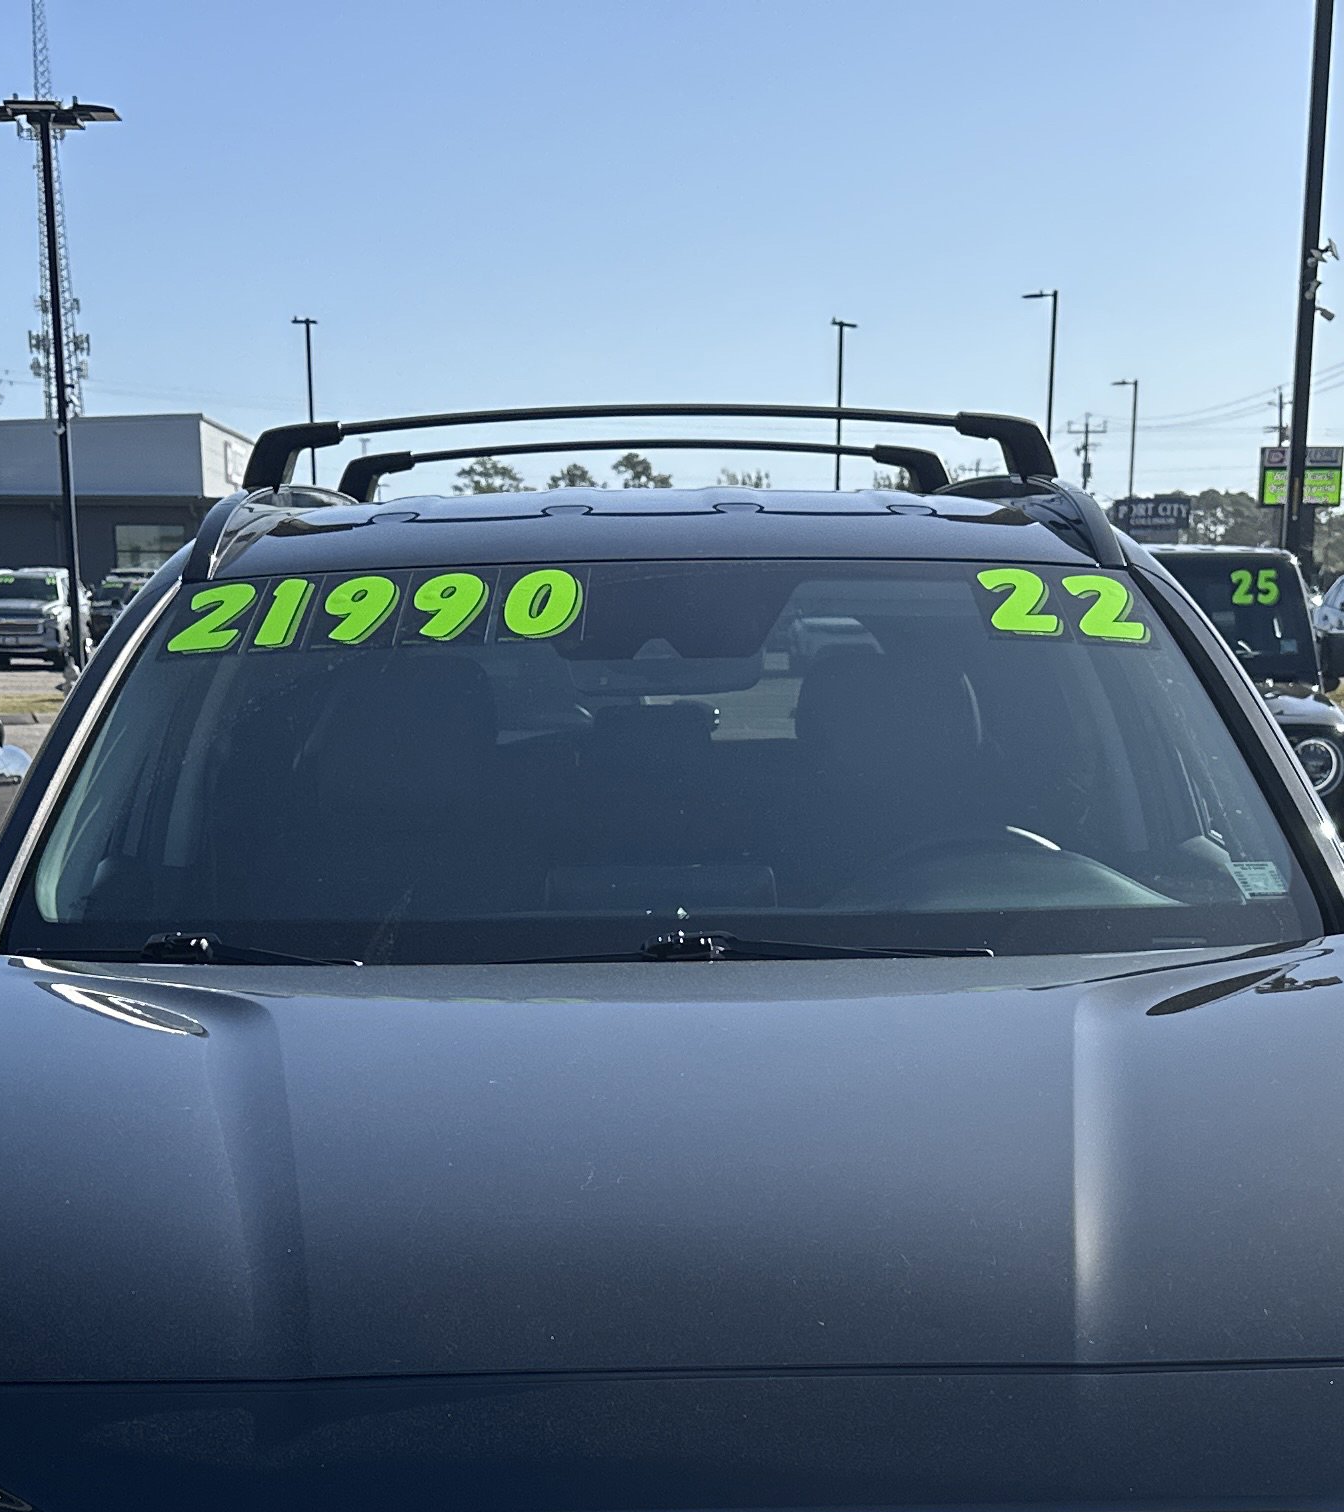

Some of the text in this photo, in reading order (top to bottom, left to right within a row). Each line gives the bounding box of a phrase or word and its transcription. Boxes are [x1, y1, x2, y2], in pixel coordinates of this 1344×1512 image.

[1158, 502, 1190, 519] CITY
[1230, 568, 1281, 606] 25
[167, 568, 1152, 654] 21990 22
